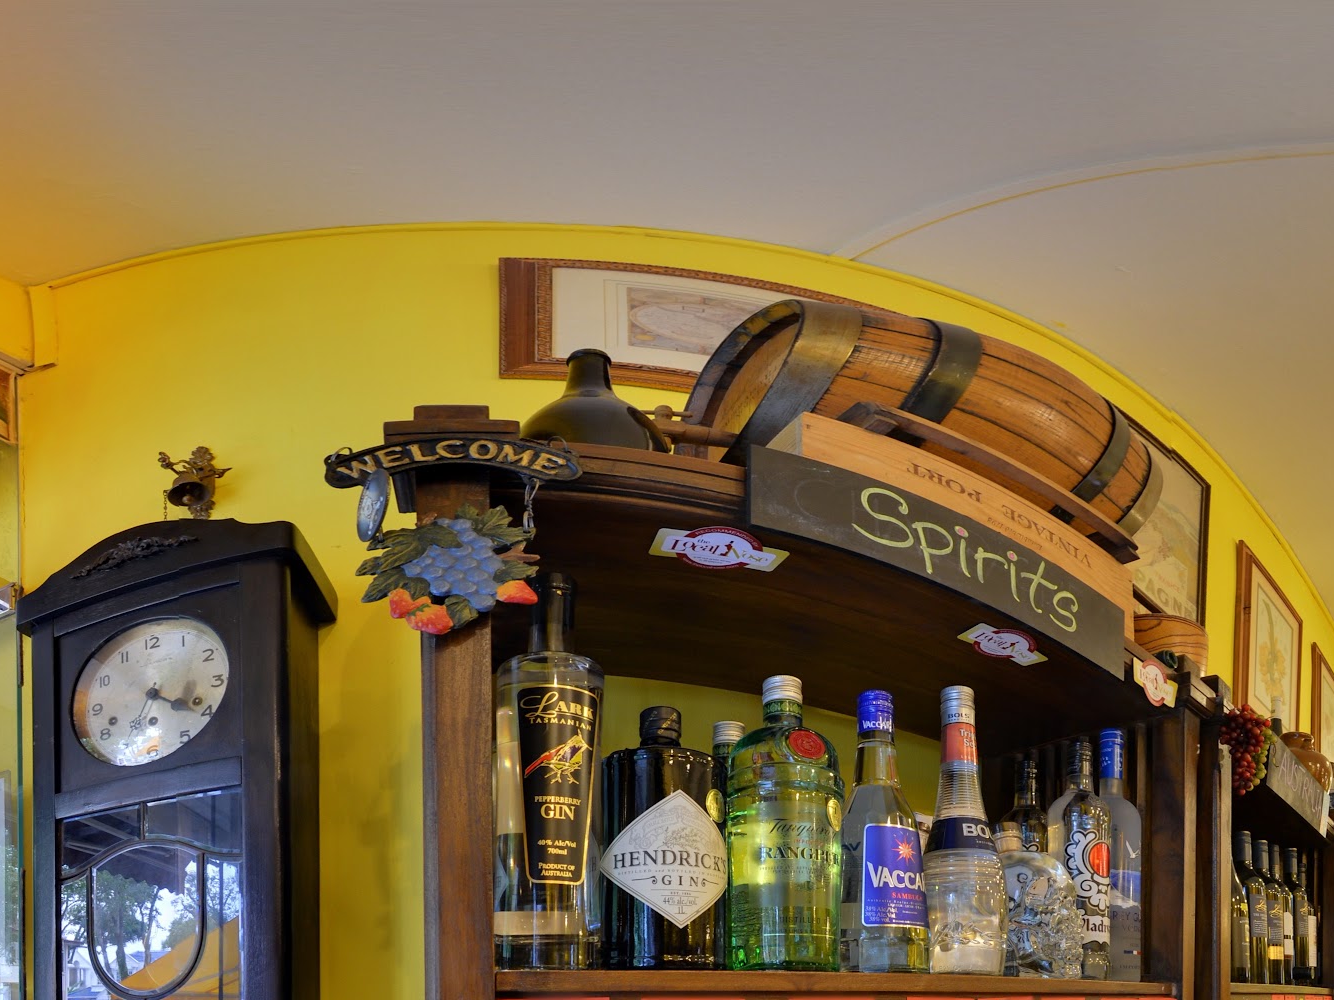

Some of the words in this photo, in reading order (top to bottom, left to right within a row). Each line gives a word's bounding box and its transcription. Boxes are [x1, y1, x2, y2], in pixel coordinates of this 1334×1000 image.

[336, 439, 567, 476] WELCOME
[907, 462, 983, 505] PORT
[1001, 504, 1092, 569] VINTAGE
[851, 487, 1078, 633] Spirits
[144, 636, 161, 651] 12
[120, 650, 129, 664] 11
[202, 648, 215, 663] 2
[99, 674, 111, 688] 10
[210, 673, 225, 688] 3
[91, 702, 104, 717] 9
[200, 704, 215, 719] 4
[529, 717, 592, 732] TASMANIAN
[99, 727, 111, 741] 8
[179, 730, 192, 745] 5
[1278, 751, 1323, 820] AUSTRALIA
[534, 795, 582, 806] PEPPERBERRY
[540, 803, 576, 821] GIN
[547, 847, 568, 856] 700ml
[538, 862, 567, 871] PRODUCT
[613, 849, 727, 875] HENDRICK'S
[540, 869, 573, 878] AUSTRALIA
[661, 874, 699, 887] GIN
